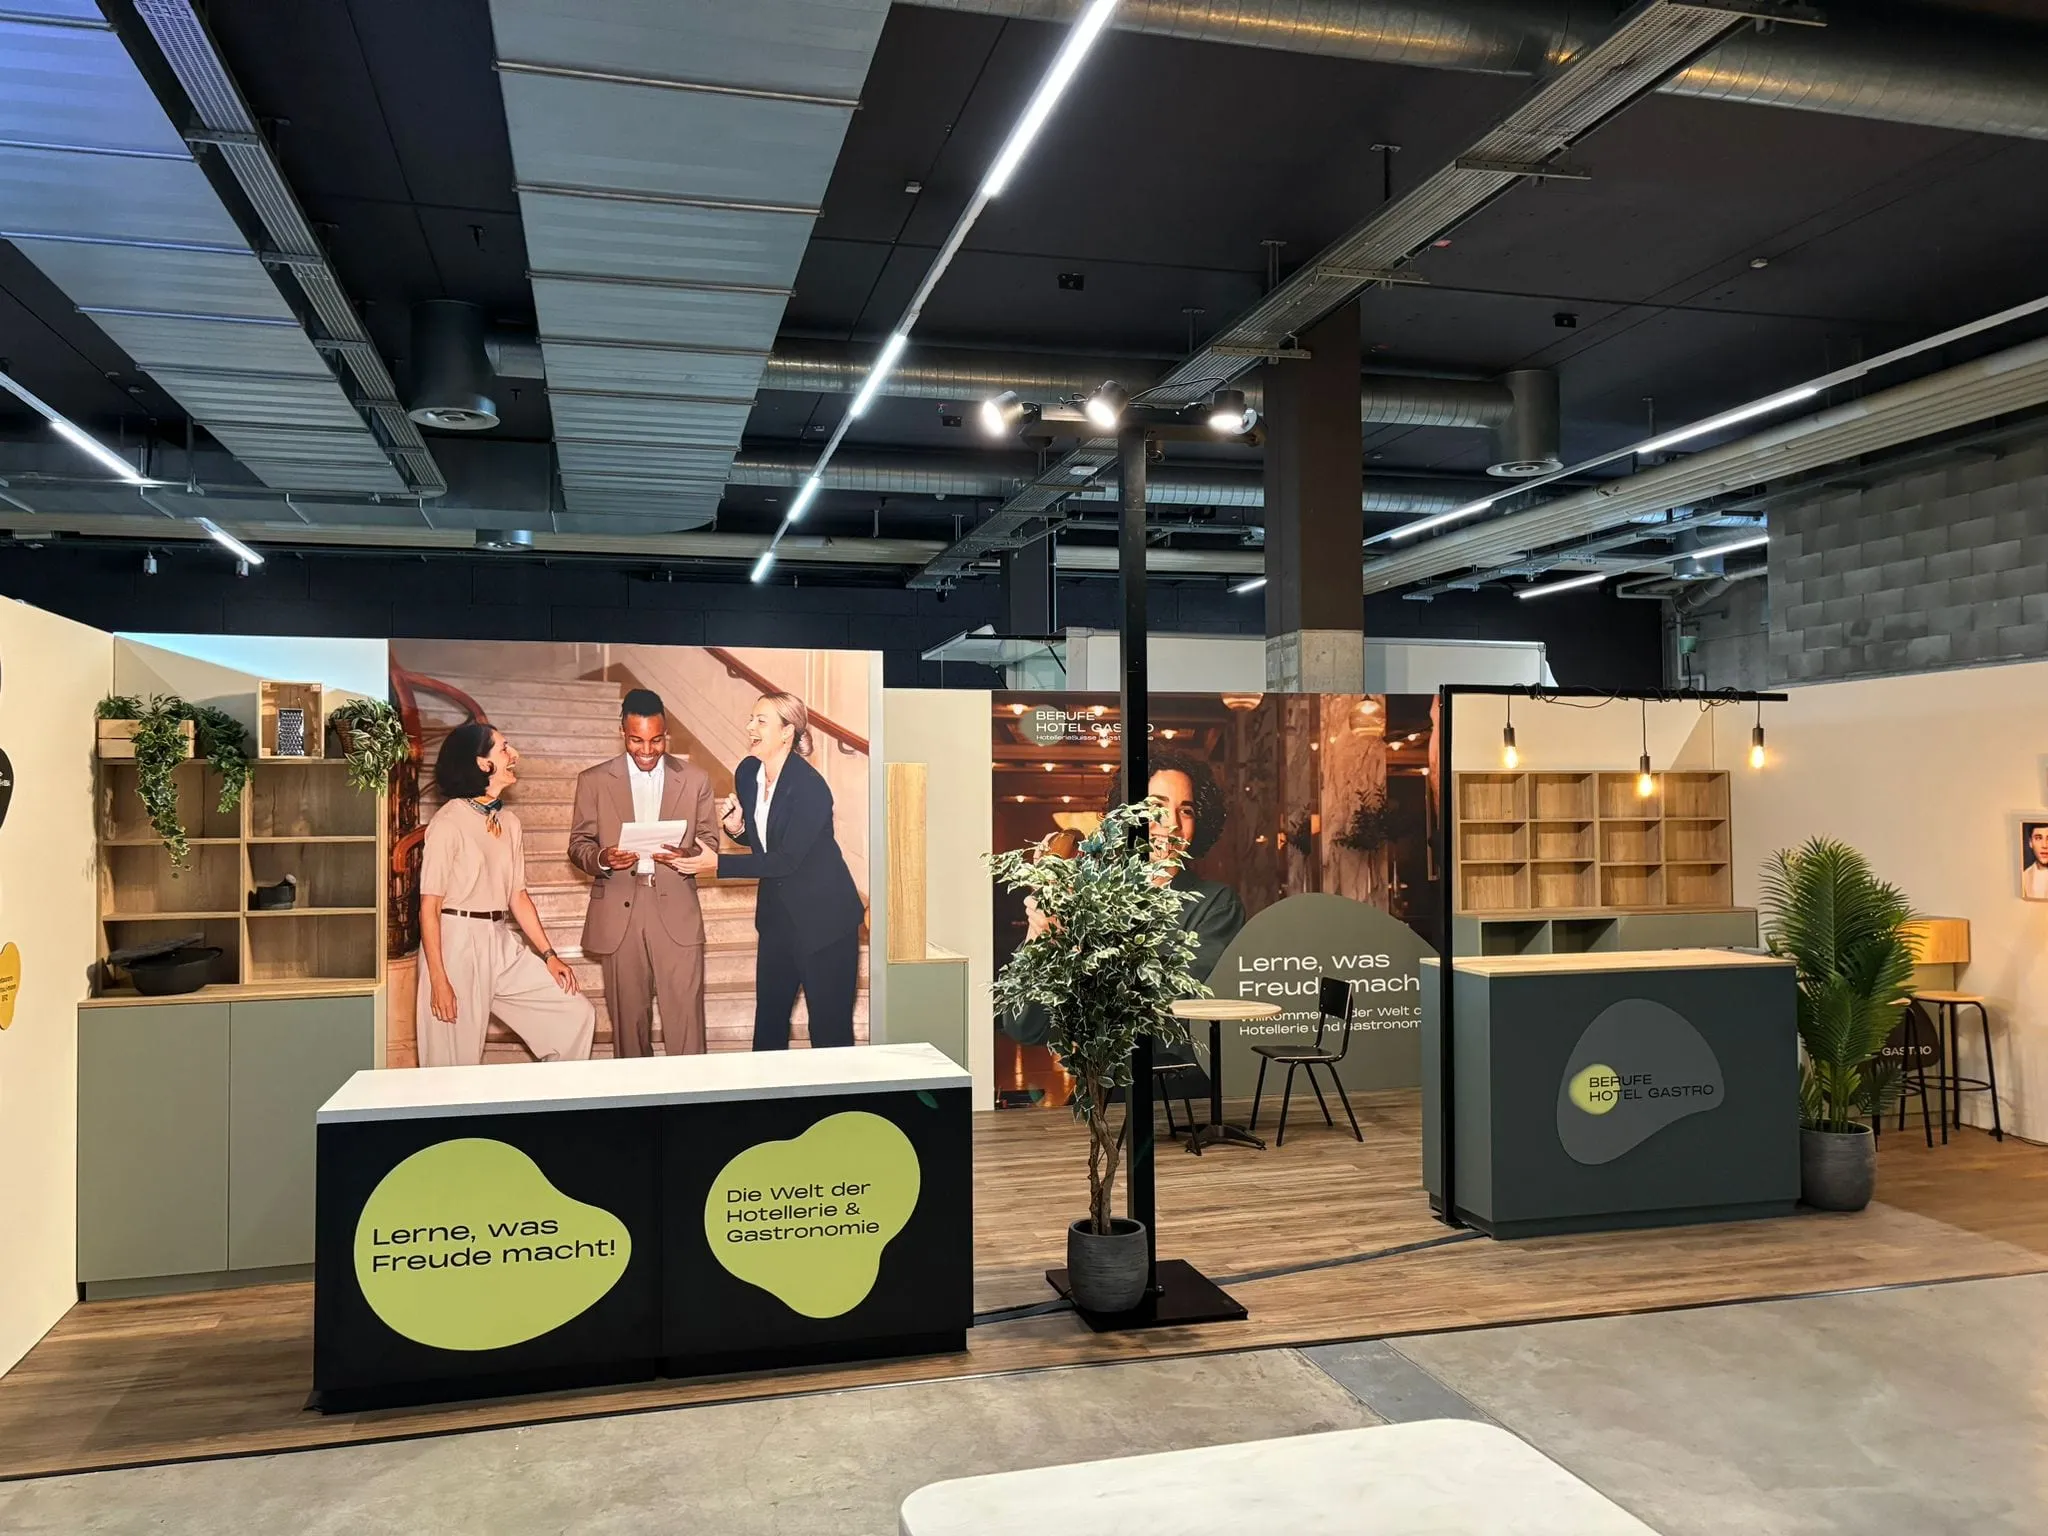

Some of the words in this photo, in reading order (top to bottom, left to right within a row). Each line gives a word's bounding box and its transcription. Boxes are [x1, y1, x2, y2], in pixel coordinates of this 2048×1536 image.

[1036, 711, 1096, 721] BERUFE
[1036, 722, 1087, 733] HOTEL
[1090, 722, 1155, 733] GASO
[1238, 954, 1323, 973] Lerne,
[1331, 953, 1390, 969] was
[1238, 976, 1320, 997] Freud
[1345, 973, 1421, 993] mach
[1377, 1005, 1410, 1016] Welt
[1239, 1023, 1309, 1036] Hotellerie
[1589, 1074, 1652, 1088] BERUFE
[1589, 1089, 1643, 1102] HOTEL
[1648, 1084, 1714, 1098] GASTRO
[727, 1187, 762, 1203] Die
[770, 1183, 824, 1201] Welt
[831, 1181, 871, 1197] der
[727, 1202, 838, 1223] Hotellerie
[845, 1202, 861, 1216] &
[372, 1224, 477, 1246] Lerne,
[487, 1219, 559, 1238] was
[727, 1219, 880, 1243] Gastronomie
[372, 1247, 492, 1273] Freude
[502, 1239, 616, 1264] macht!
